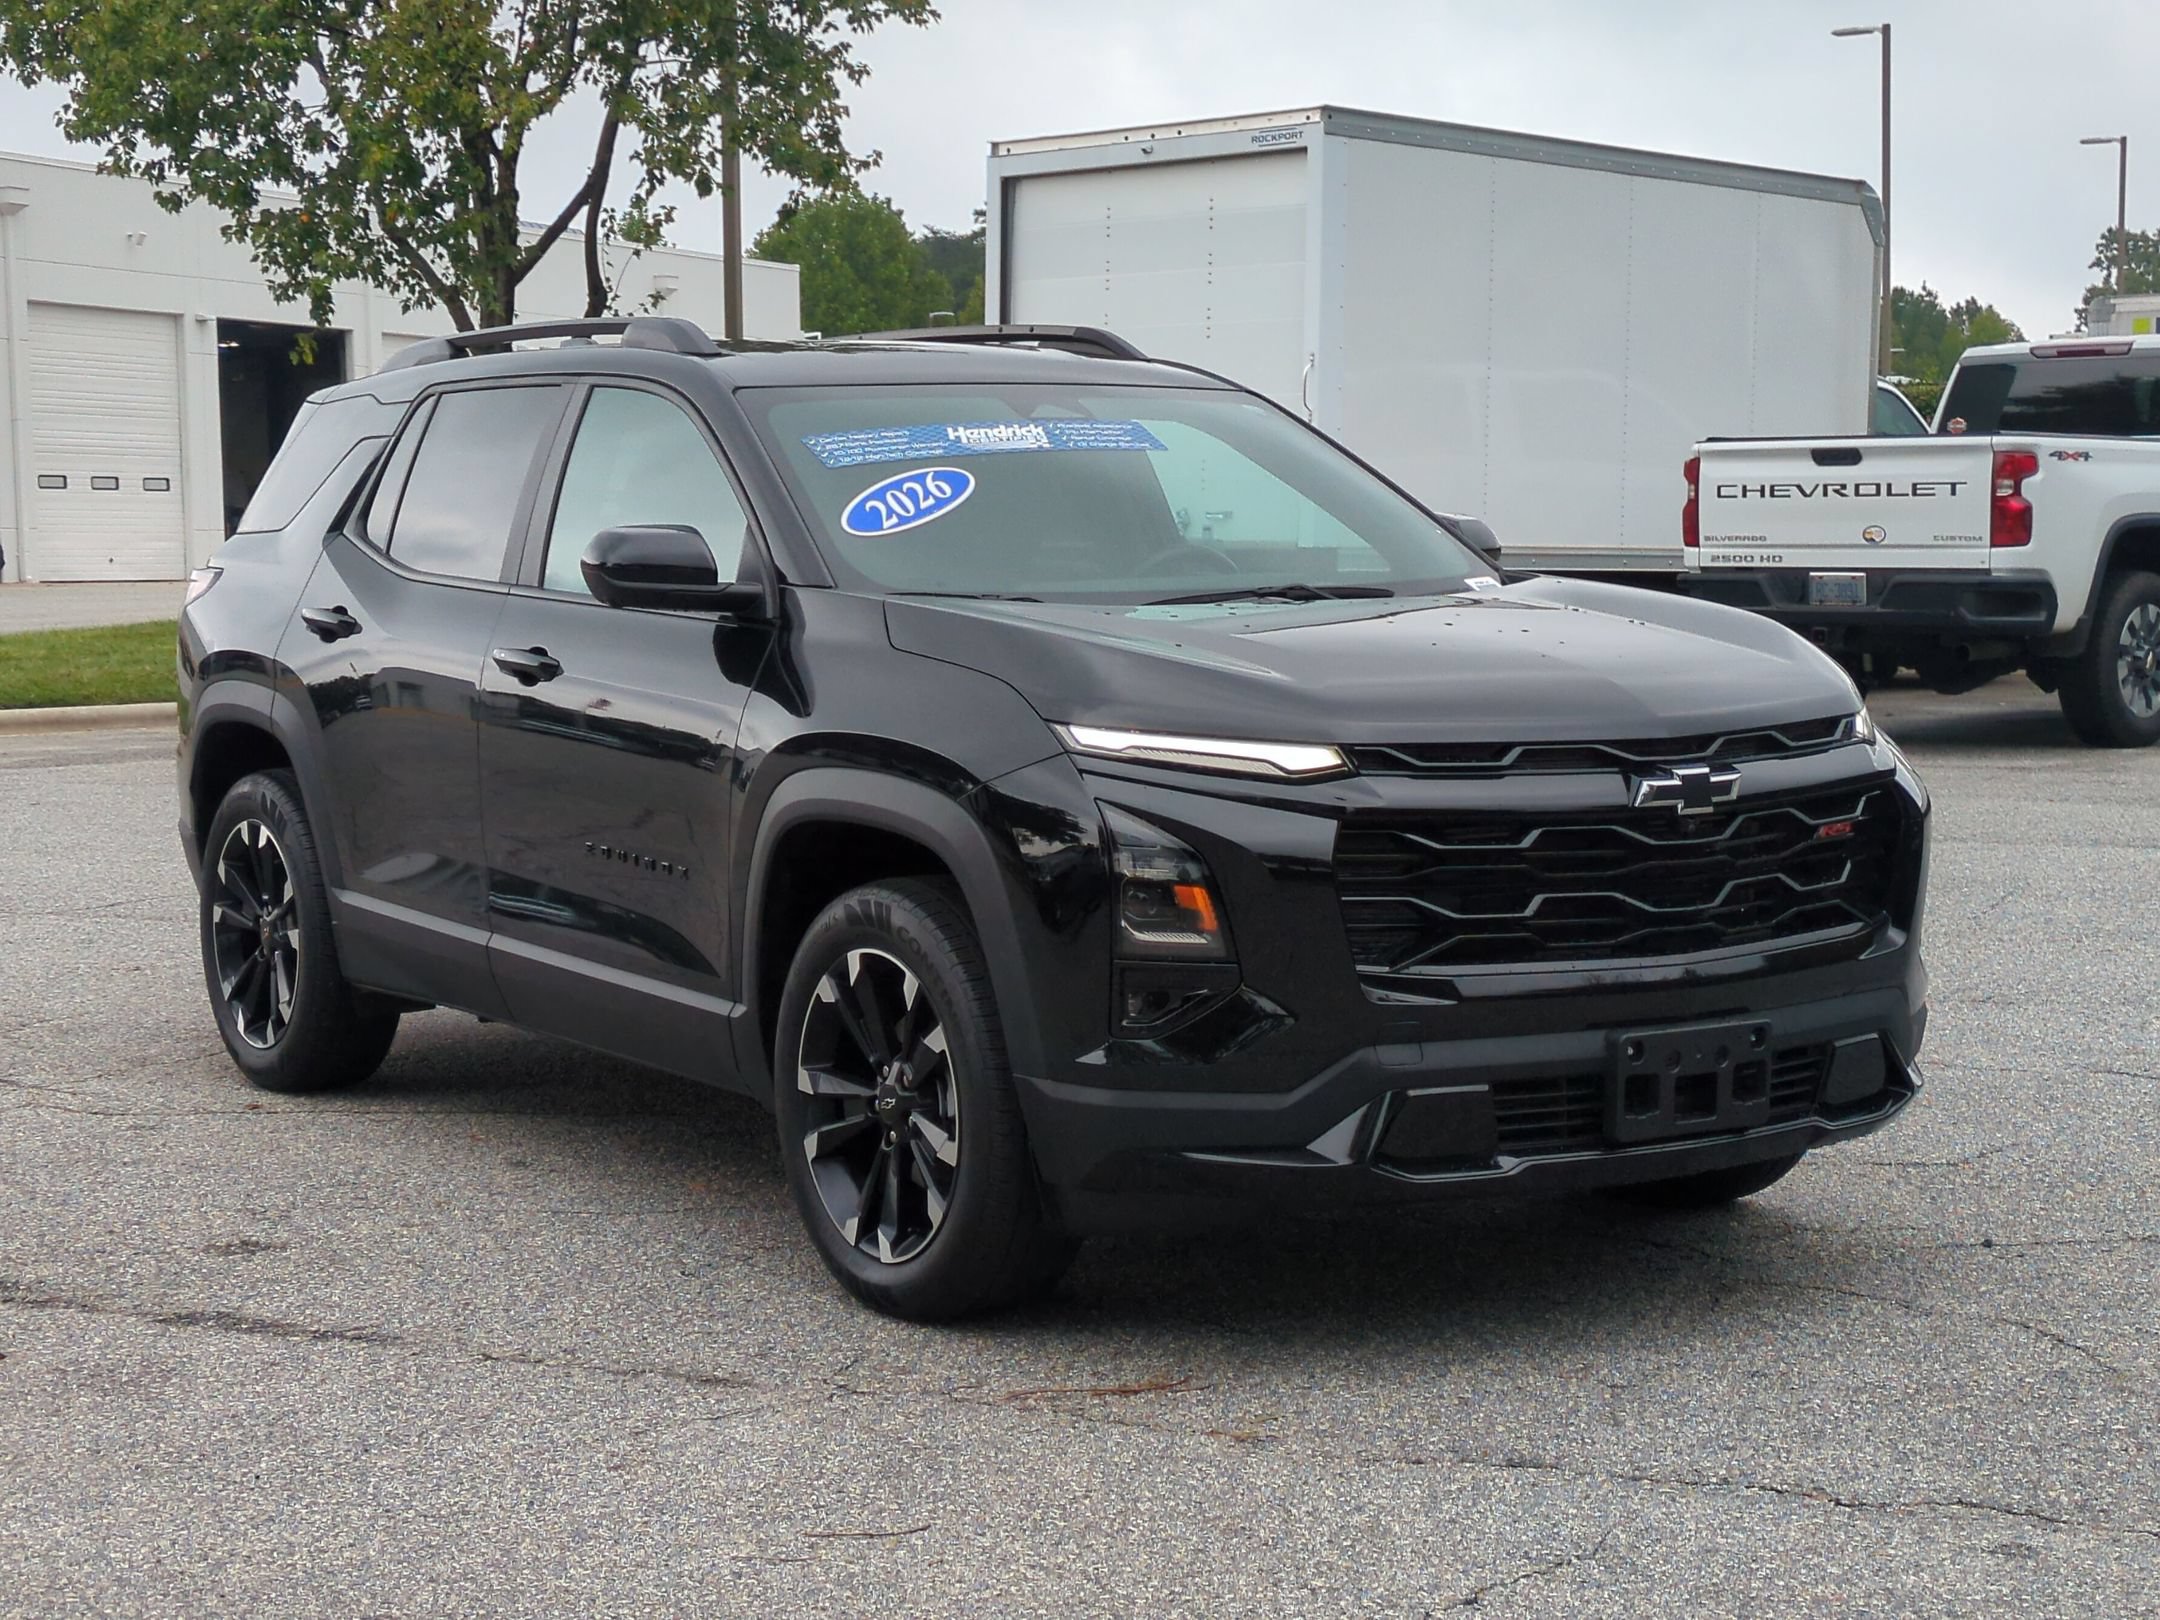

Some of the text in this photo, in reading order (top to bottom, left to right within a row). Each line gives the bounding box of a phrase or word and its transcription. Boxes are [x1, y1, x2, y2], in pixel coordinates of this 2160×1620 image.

[1251, 131, 1304, 144] ROCKPORT
[947, 424, 1048, 444] Hendrick
[1716, 481, 1968, 499] CHEVROLET
[865, 471, 952, 531] 2026
[1711, 554, 1783, 563] 2500 HD
